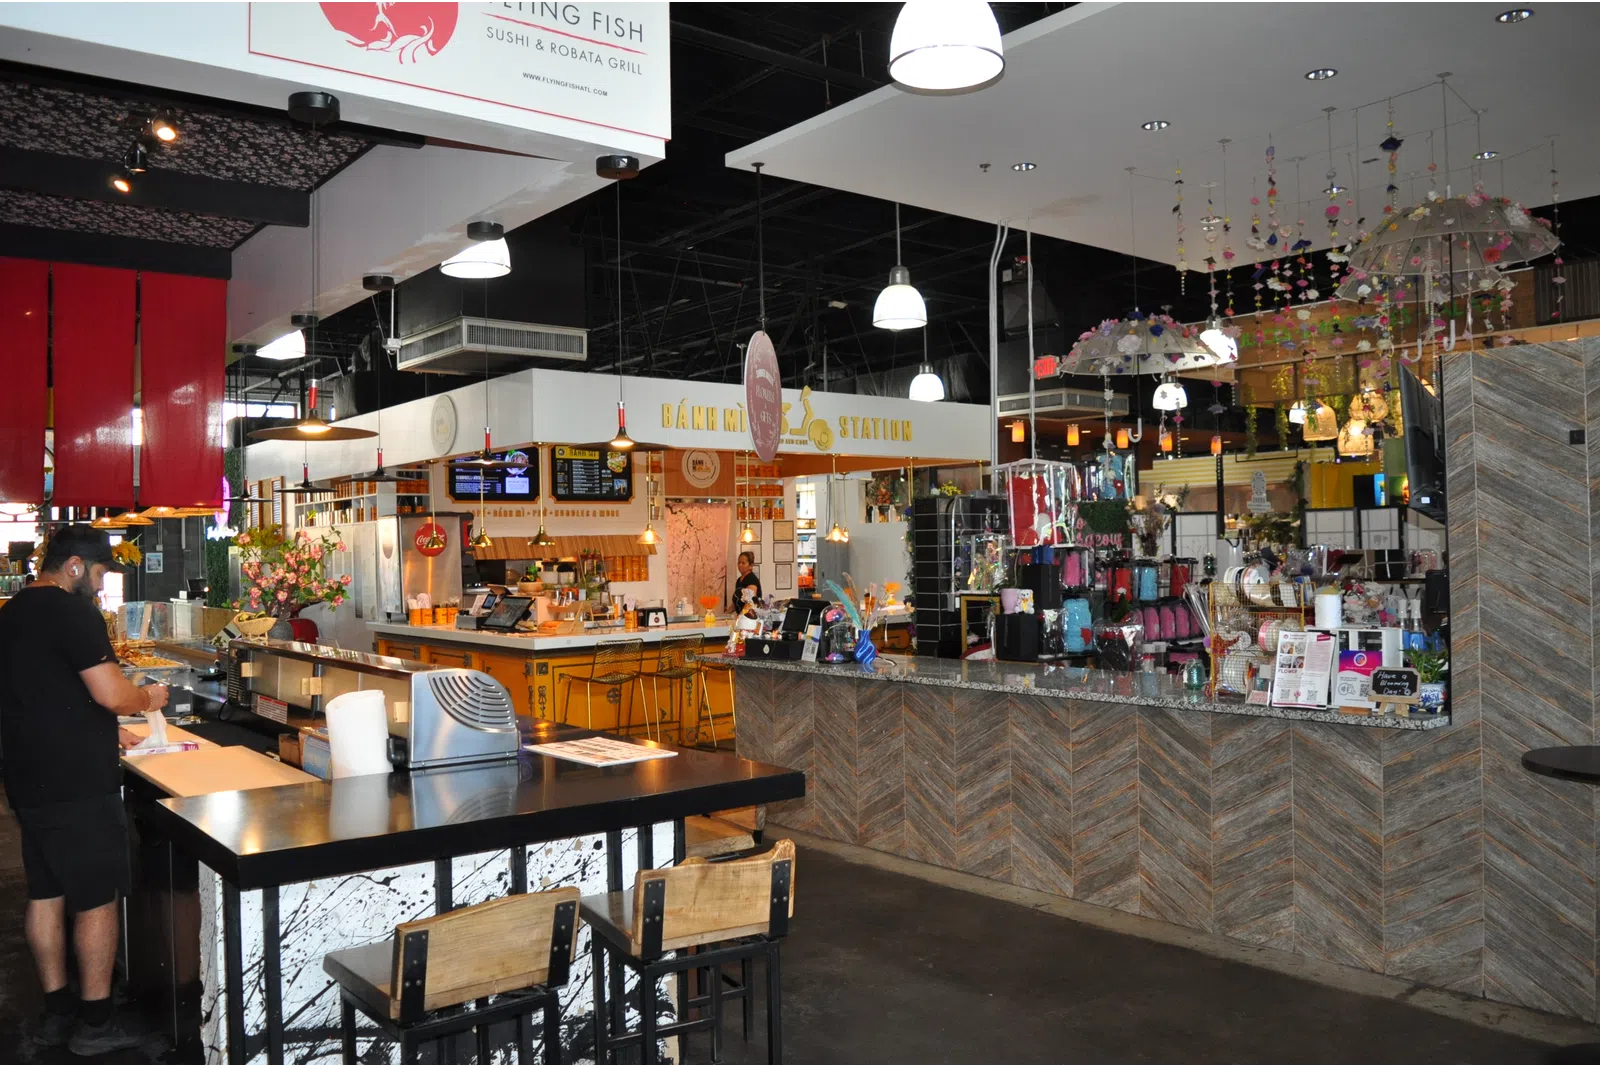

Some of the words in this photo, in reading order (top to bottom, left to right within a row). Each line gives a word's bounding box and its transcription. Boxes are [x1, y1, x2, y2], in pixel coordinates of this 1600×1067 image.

[488, 0, 580, 25] ING
[593, 11, 643, 43] FISH
[486, 26, 529, 48] SUSHI
[535, 39, 545, 51] &
[550, 42, 603, 66] ROBATA
[608, 57, 642, 75] GRILL
[522, 72, 608, 97] WWW.FLYINGFISHATL.COM
[661, 397, 718, 431] BÁNH
[723, 401, 746, 433] MÌ
[838, 415, 913, 442] STATION
[1377, 671, 1397, 680] Have
[1380, 681, 1410, 690] Blooming
